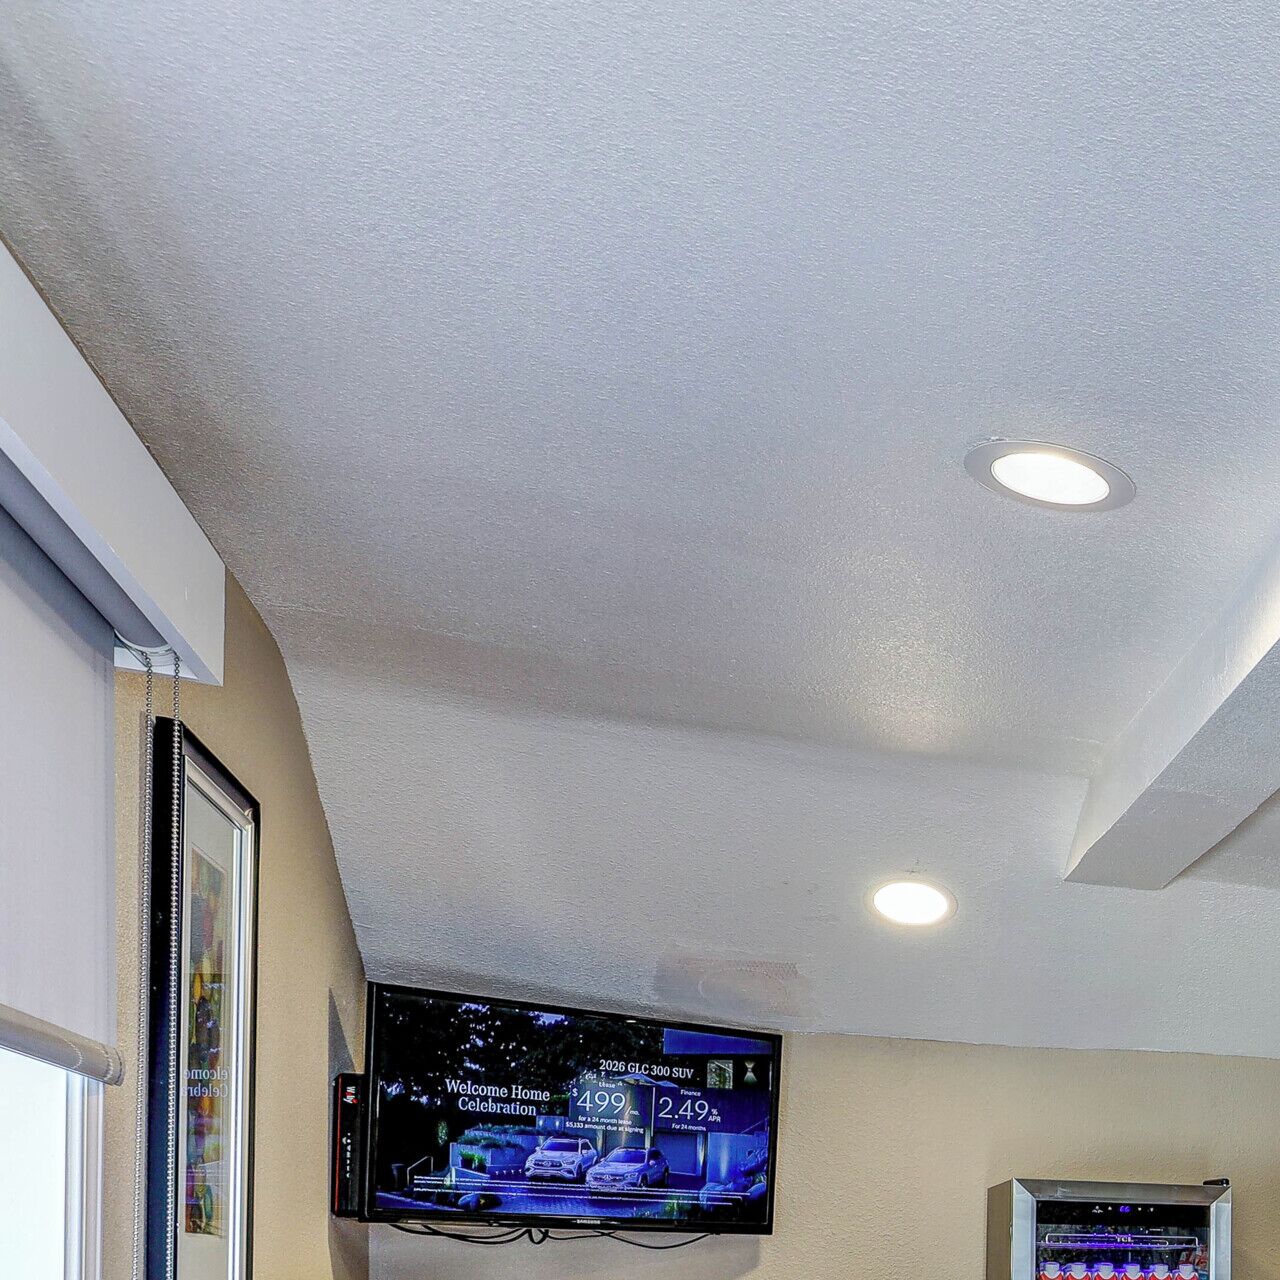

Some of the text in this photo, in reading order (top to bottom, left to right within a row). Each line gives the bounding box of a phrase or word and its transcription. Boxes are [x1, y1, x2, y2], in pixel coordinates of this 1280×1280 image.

[599, 1059, 694, 1079] 2026 GLC 300 SUV
[445, 1079, 550, 1101] Welcome Home
[680, 1089, 701, 1097] Finance
[458, 1097, 537, 1116] Celebration
[658, 1097, 709, 1121] 2.49
[585, 1123, 606, 1131] amount
